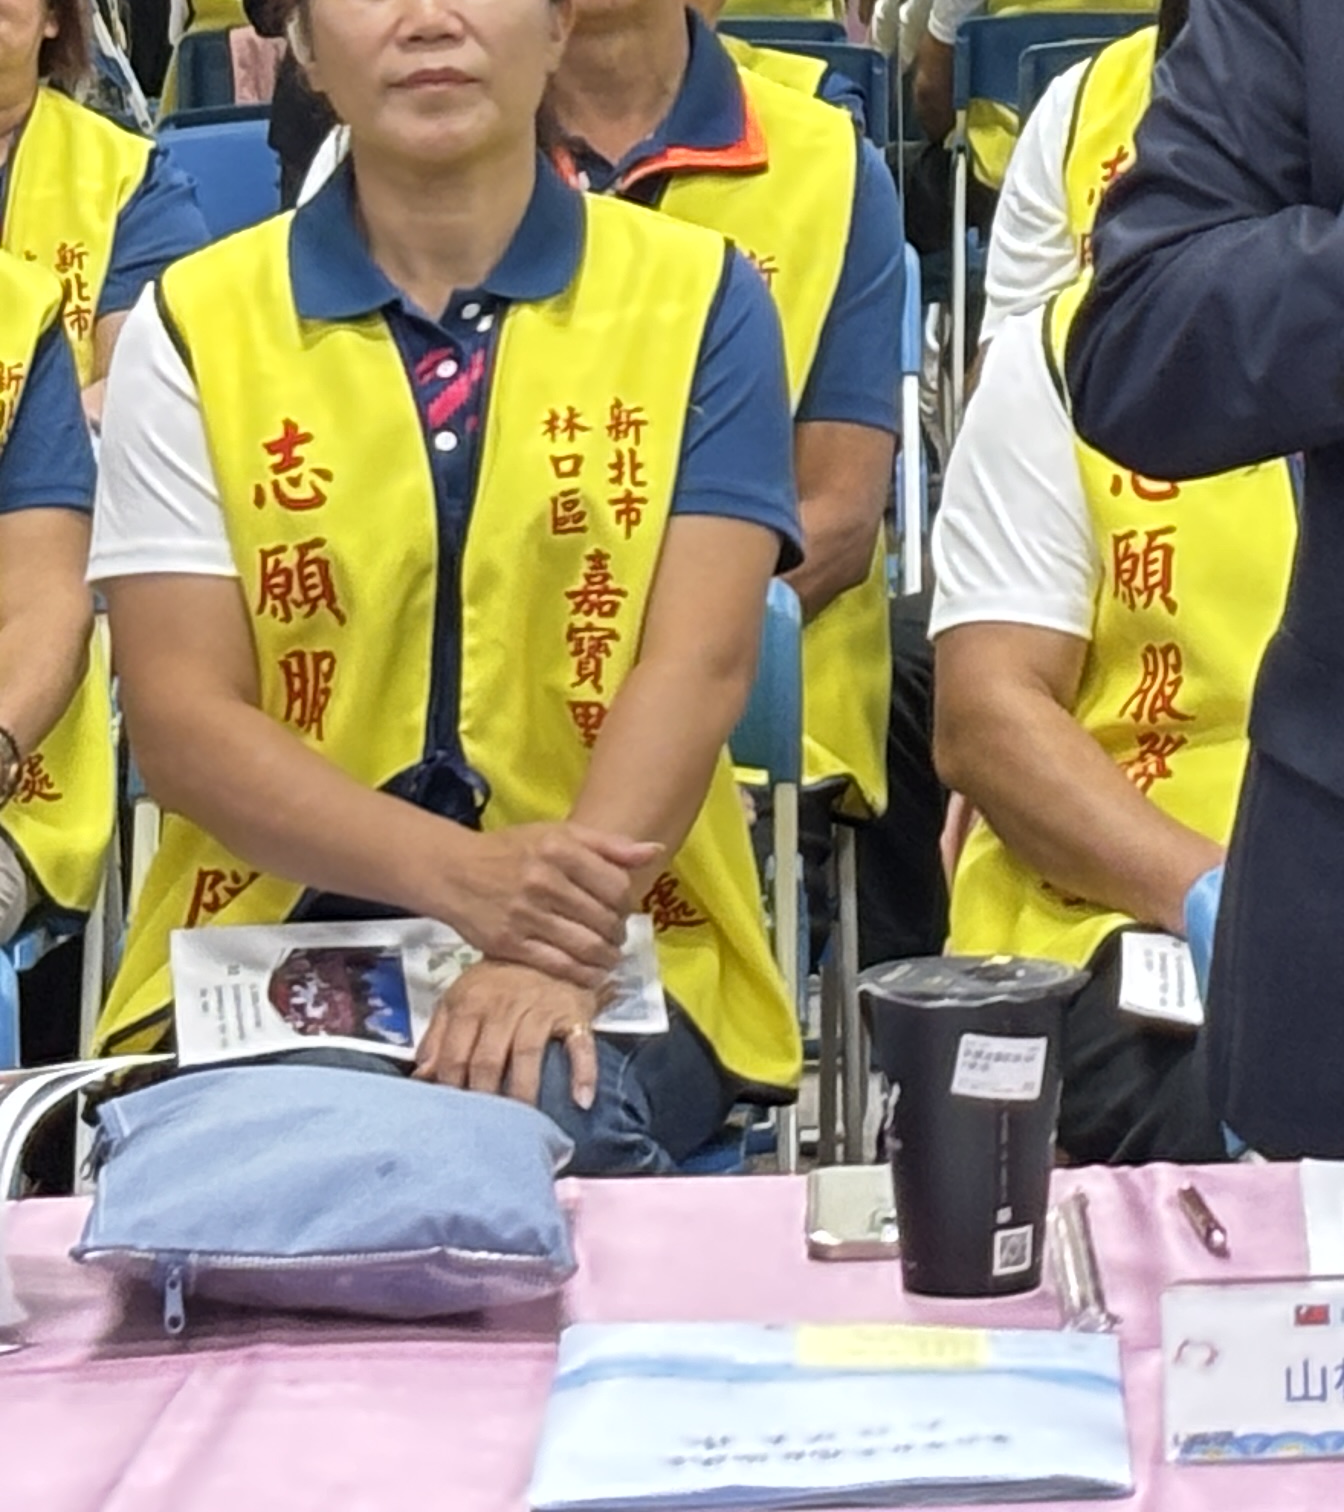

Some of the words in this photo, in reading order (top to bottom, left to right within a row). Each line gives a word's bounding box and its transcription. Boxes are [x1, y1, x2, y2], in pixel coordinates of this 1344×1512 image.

[54, 241, 93, 341] 新北市
[542, 406, 592, 536] 林口區
[606, 397, 649, 540] 新北市
